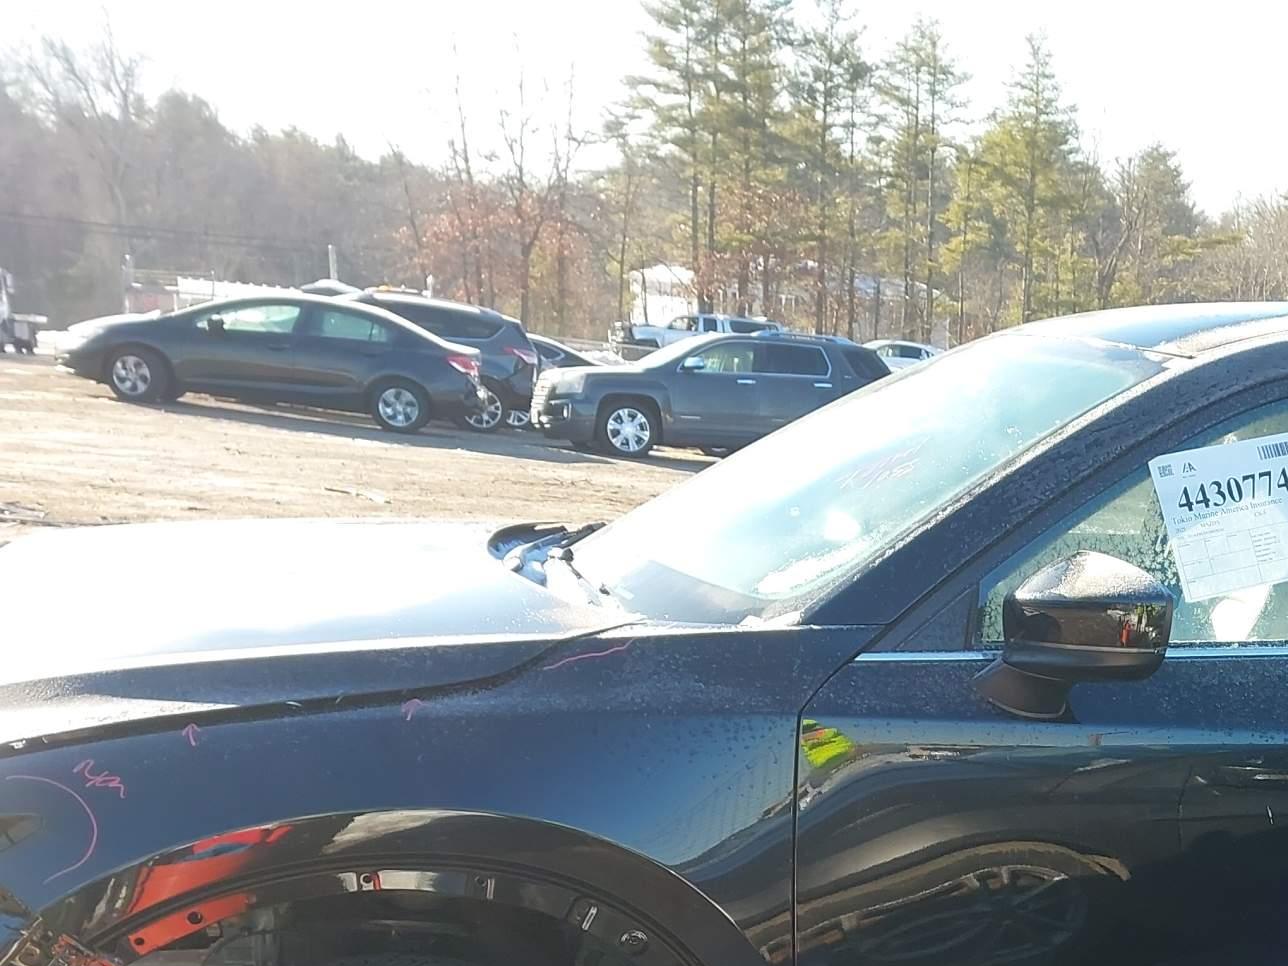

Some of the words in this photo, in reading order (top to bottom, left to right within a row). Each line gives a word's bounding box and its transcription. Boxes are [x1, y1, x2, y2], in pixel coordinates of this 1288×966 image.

[1172, 516, 1193, 525] Tokio
[1194, 510, 1219, 520] Marine
[1220, 504, 1249, 515] America
[1250, 498, 1283, 509] Insurance
